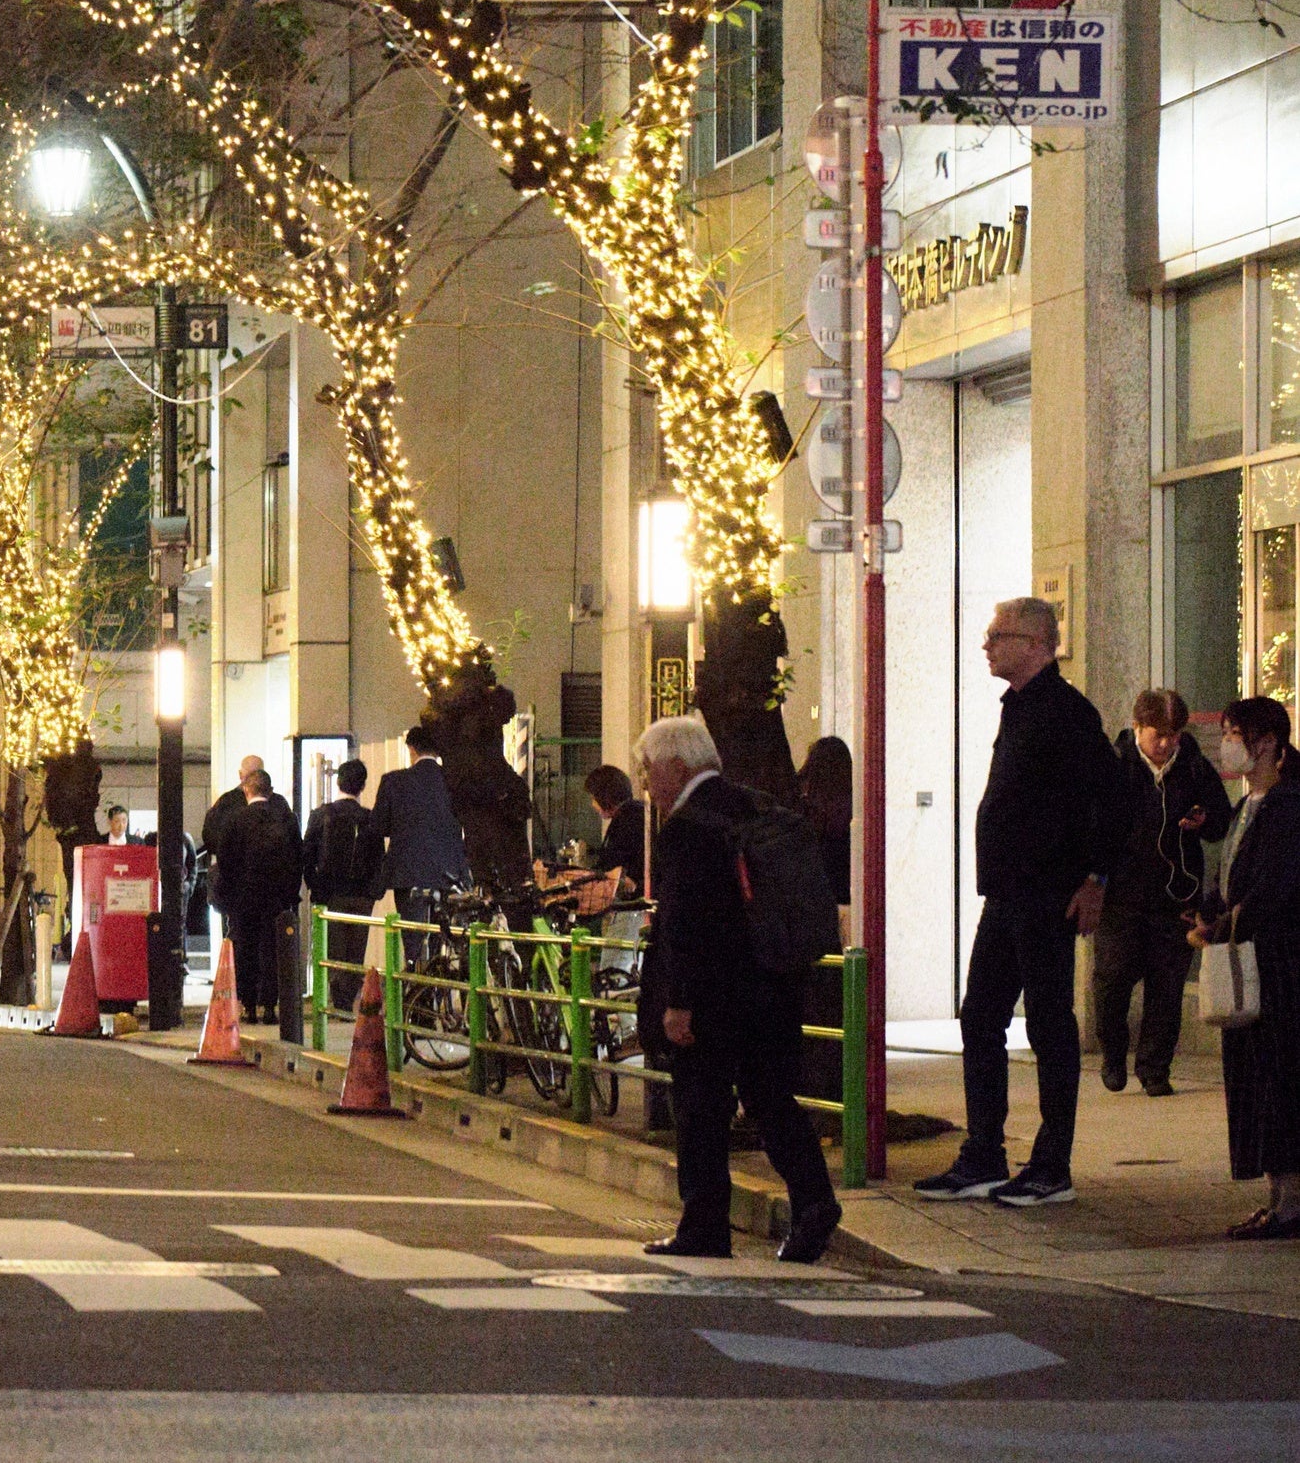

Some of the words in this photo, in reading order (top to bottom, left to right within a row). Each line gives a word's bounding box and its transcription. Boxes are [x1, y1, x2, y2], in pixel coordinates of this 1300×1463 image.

[900, 18, 1105, 39] 不動産は信頼の
[917, 46, 1081, 92] KEN
[189, 318, 218, 343] 81
